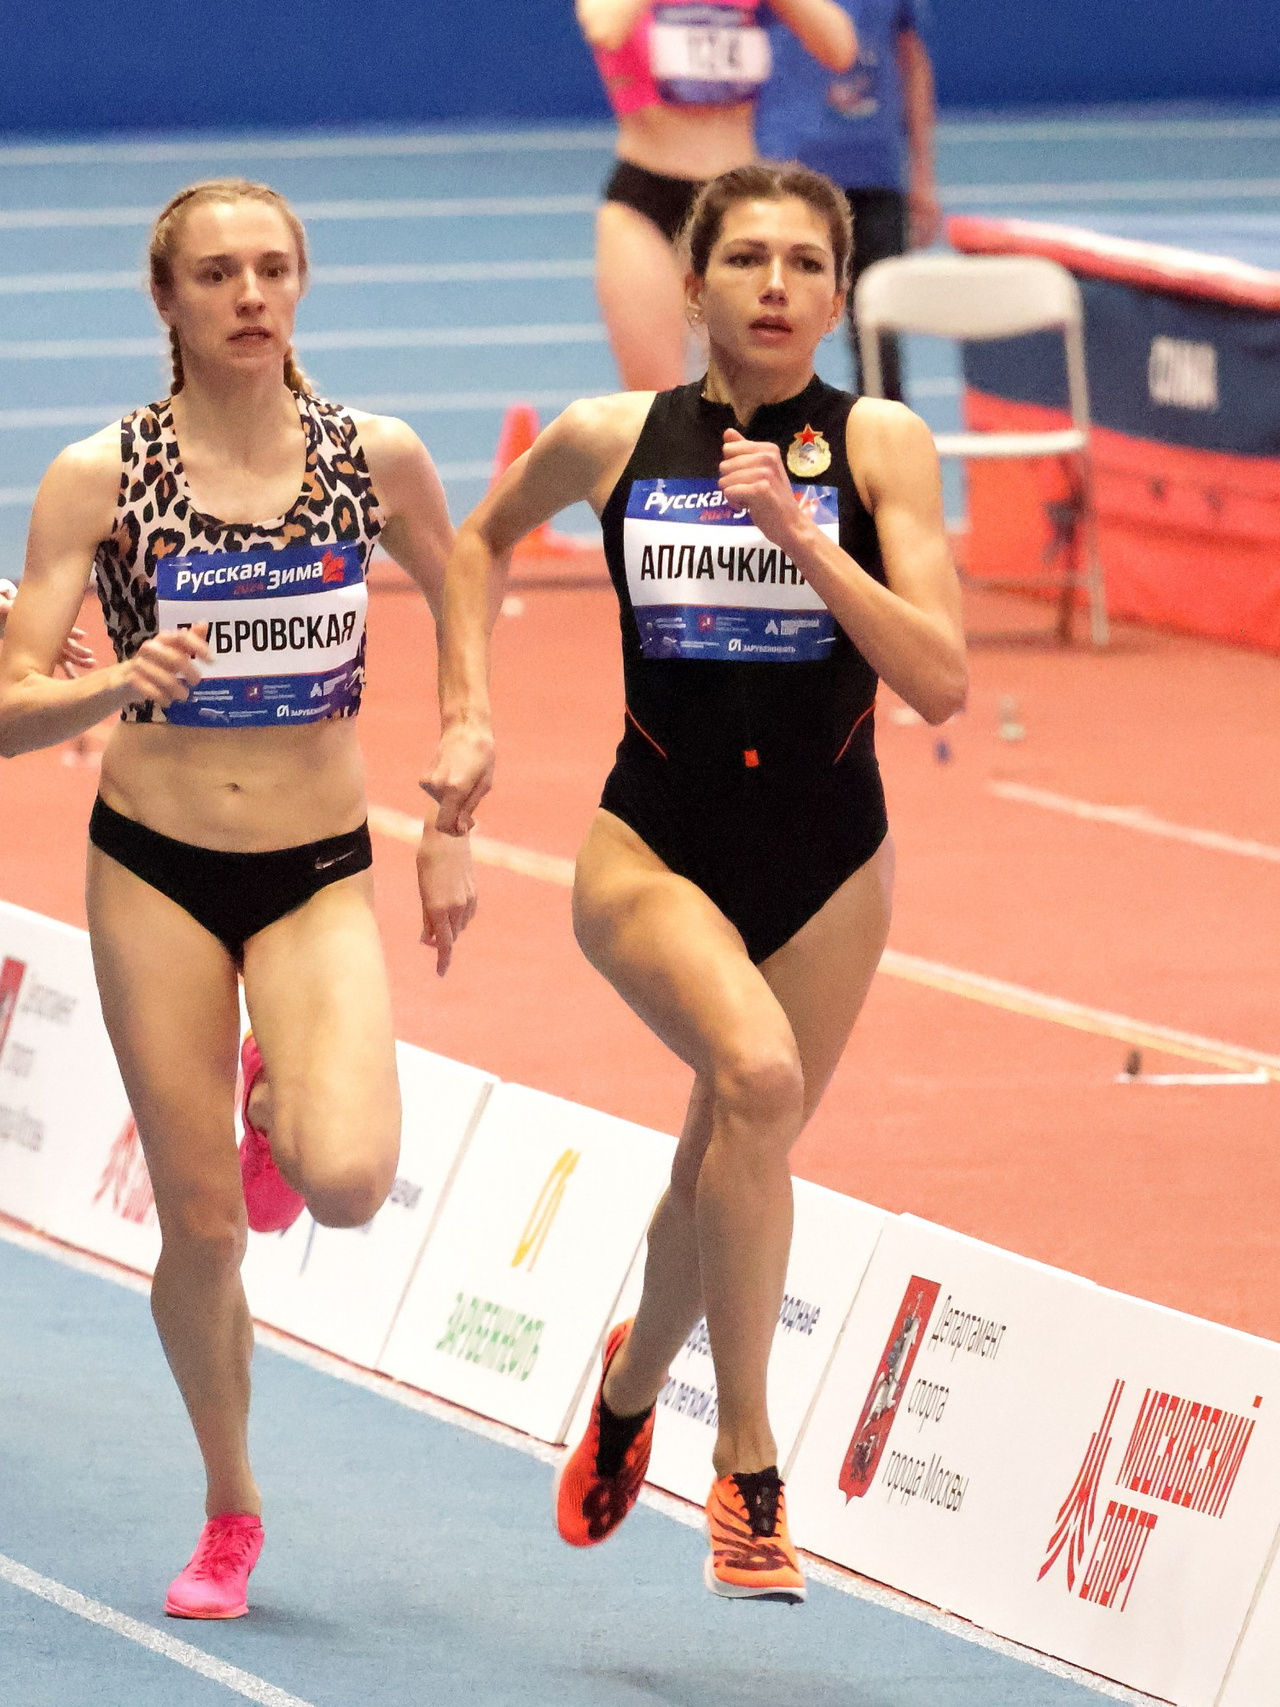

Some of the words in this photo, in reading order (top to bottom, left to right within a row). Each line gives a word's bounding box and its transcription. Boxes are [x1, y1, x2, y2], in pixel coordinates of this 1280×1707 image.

[176, 560, 267, 593] Русская
[266, 561, 324, 591] Зима
[640, 545, 807, 585] АПЛАЧКИН
[926, 1295, 1007, 1362] Департамент
[907, 1378, 950, 1434] спорта
[881, 1450, 927, 1506] города
[920, 1452, 970, 1513] Москвы
[1115, 1388, 1263, 1520] МОСКОВСКИЙ
[1078, 1500, 1158, 1613] СПОРТ
